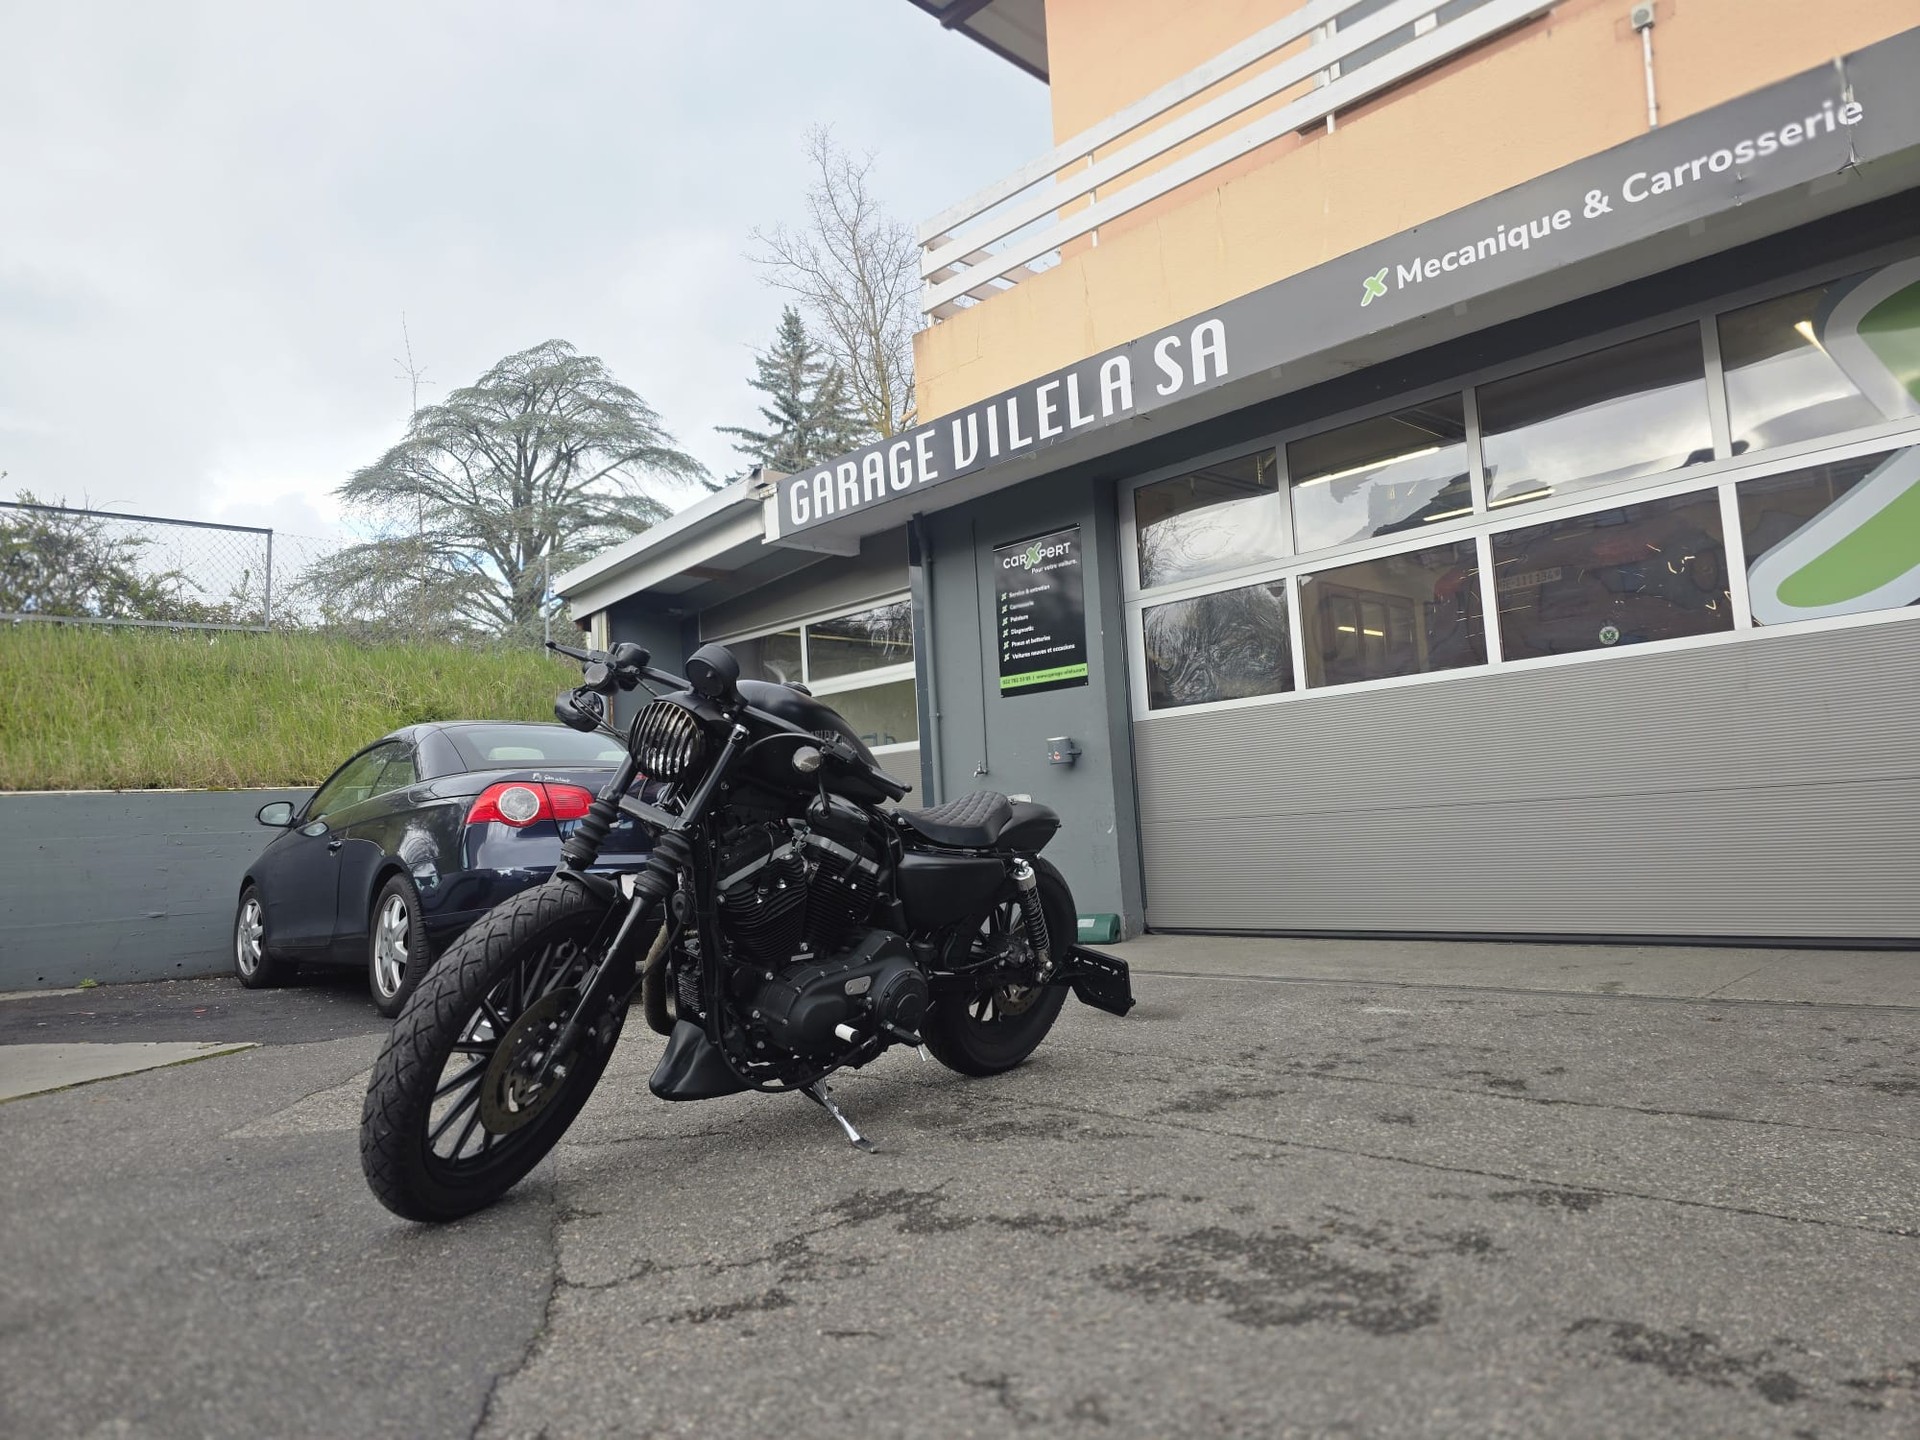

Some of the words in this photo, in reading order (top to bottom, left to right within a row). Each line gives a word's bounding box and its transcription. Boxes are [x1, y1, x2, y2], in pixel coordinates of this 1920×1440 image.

[1396, 206, 1572, 289] Mecanique
[1583, 189, 1613, 219] &
[1622, 98, 1863, 203] Carrosserie
[789, 430, 938, 526] GARAGE
[951, 355, 1135, 471] VILELA
[1153, 318, 1229, 397] SA
[1031, 566, 1043, 574] Pour
[1044, 563, 1058, 571] votre
[1012, 651, 1031, 660] Voitures
[1053, 643, 1076, 652] occasions
